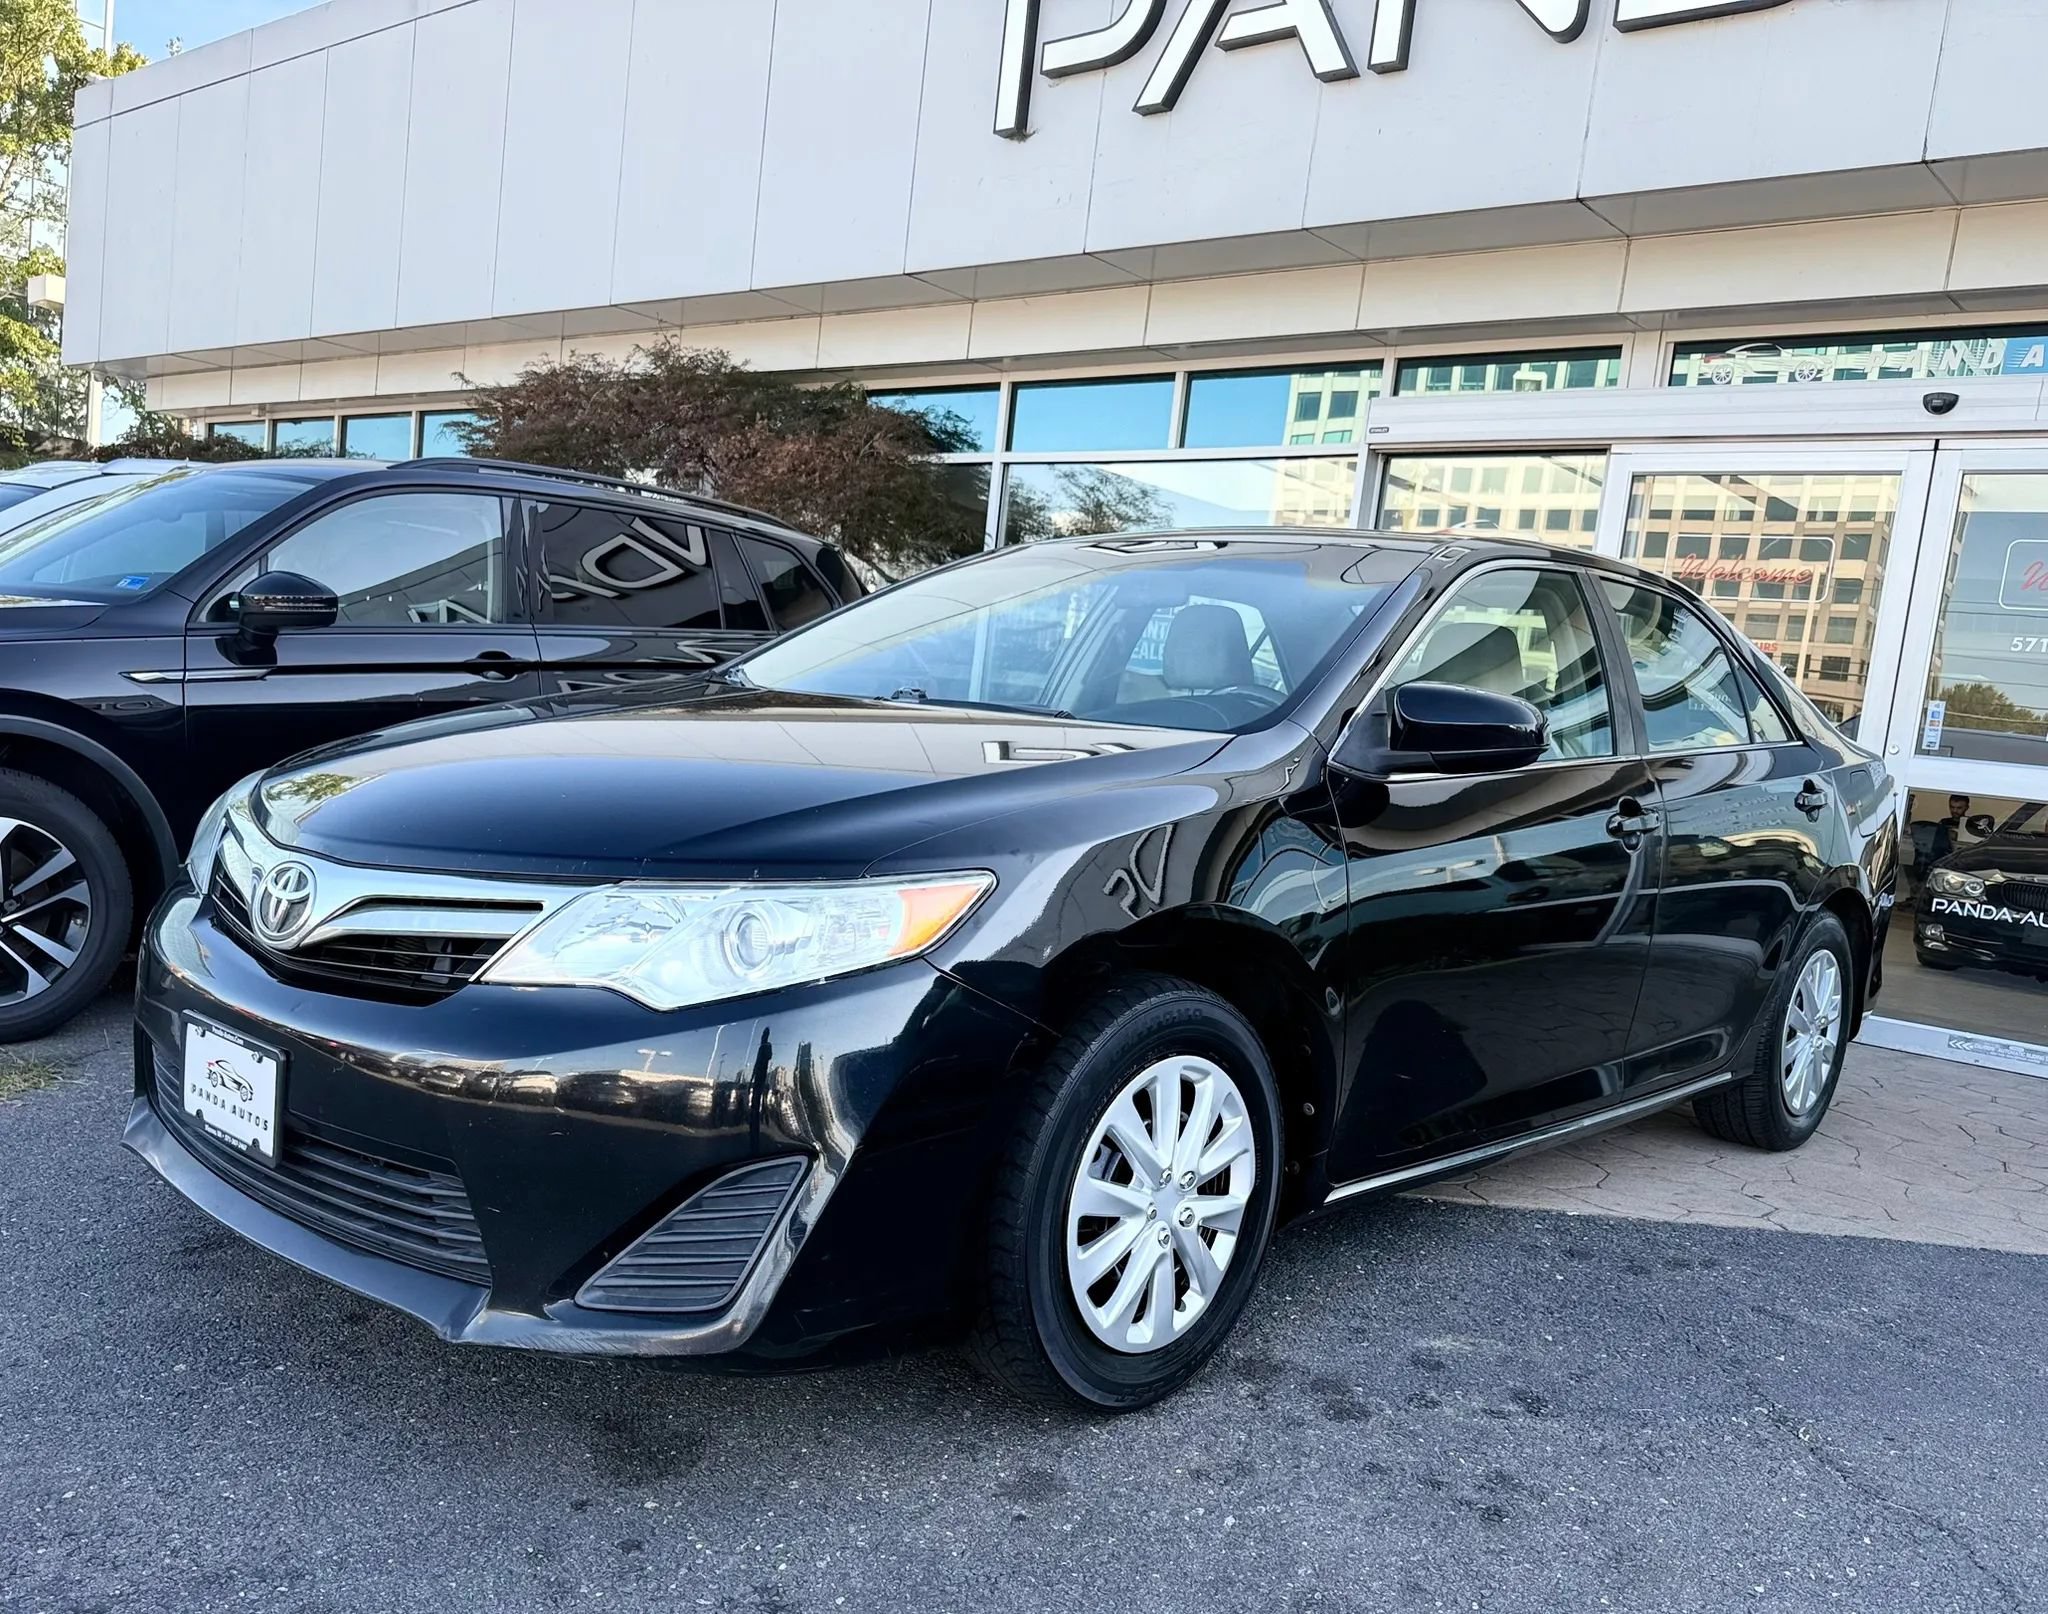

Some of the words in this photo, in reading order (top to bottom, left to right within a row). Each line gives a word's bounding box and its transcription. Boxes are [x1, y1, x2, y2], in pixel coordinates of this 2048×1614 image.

[1679, 553, 1815, 584] Welcome
[190, 1083, 226, 1110] PANDA
[231, 1104, 268, 1131] AUTOS
